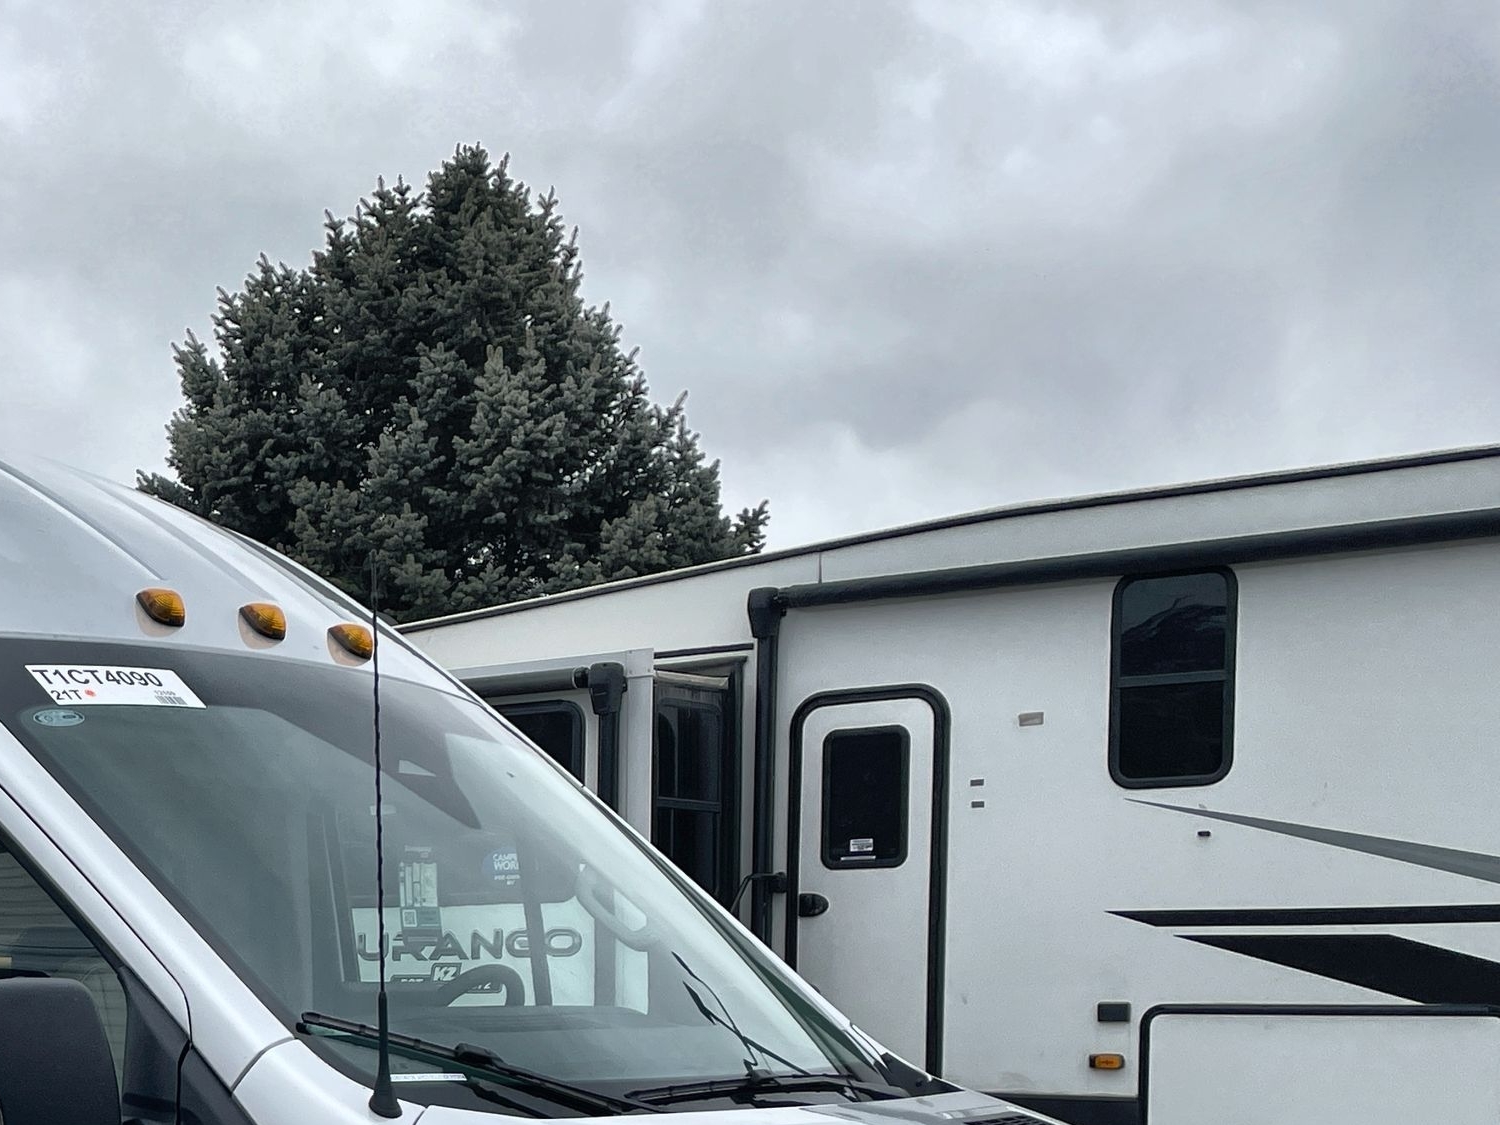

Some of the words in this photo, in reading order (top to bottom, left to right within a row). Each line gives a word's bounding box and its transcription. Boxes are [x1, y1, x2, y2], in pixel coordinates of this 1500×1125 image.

[31, 669, 163, 688] T1CT4090
[50, 689, 83, 701] 21T
[433, 966, 458, 982] KZ
